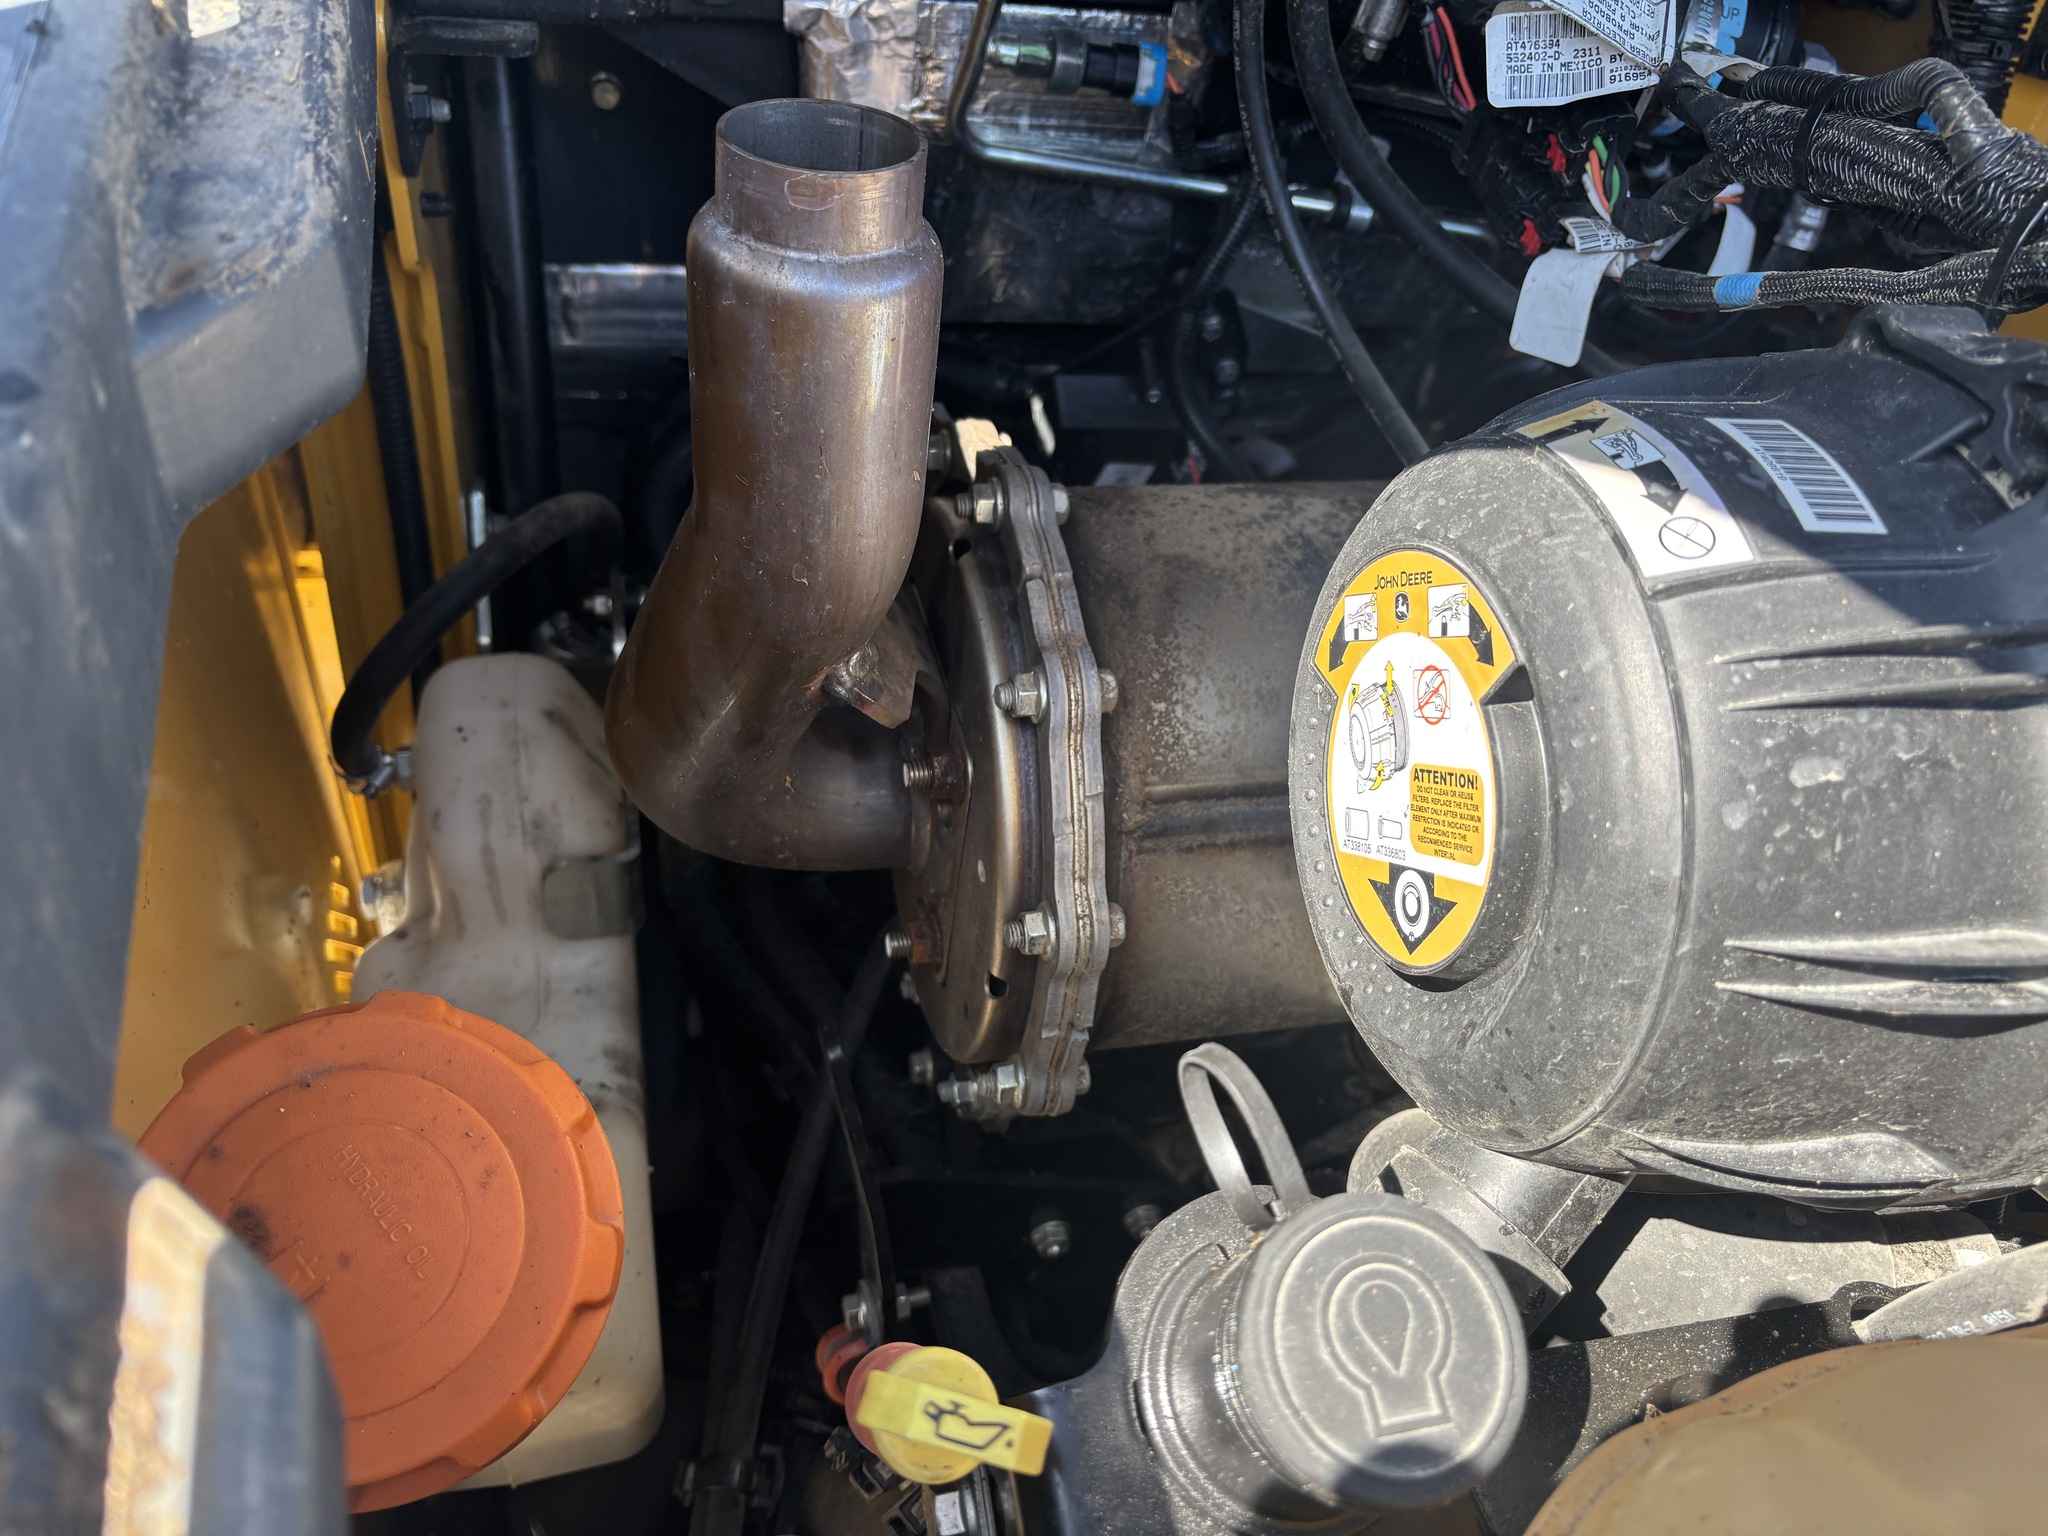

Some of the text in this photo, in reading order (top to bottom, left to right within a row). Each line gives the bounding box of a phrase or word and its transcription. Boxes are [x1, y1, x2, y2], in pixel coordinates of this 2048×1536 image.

[1588, 0, 1635, 40] APROBADA
[1506, 46, 1601, 63] 552402-D 2311
[1506, 64, 1533, 74] MADE
[1541, 62, 1554, 72] IN
[1560, 57, 1602, 71] MEXICO
[1374, 571, 1433, 590] JOHN DEERE
[1413, 767, 1478, 790] ATTENTION!
[1416, 785, 1474, 801] DO NOT CLEAN OR REUSE
[1410, 803, 1482, 824] ELEMENT ONLY AFTER MAXIMUM
[1431, 797, 1453, 808] REPLACE
[1453, 800, 1462, 809] THE
[1463, 802, 1480, 813] FILTER
[1412, 813, 1480, 834] RESTRICTION IS INDICATED OR
[1422, 826, 1468, 842] ACCORDING TO THE
[1417, 834, 1474, 854] RECOMMENDED SERVICE
[333, 1144, 434, 1279] HYDRAULIC OIL
